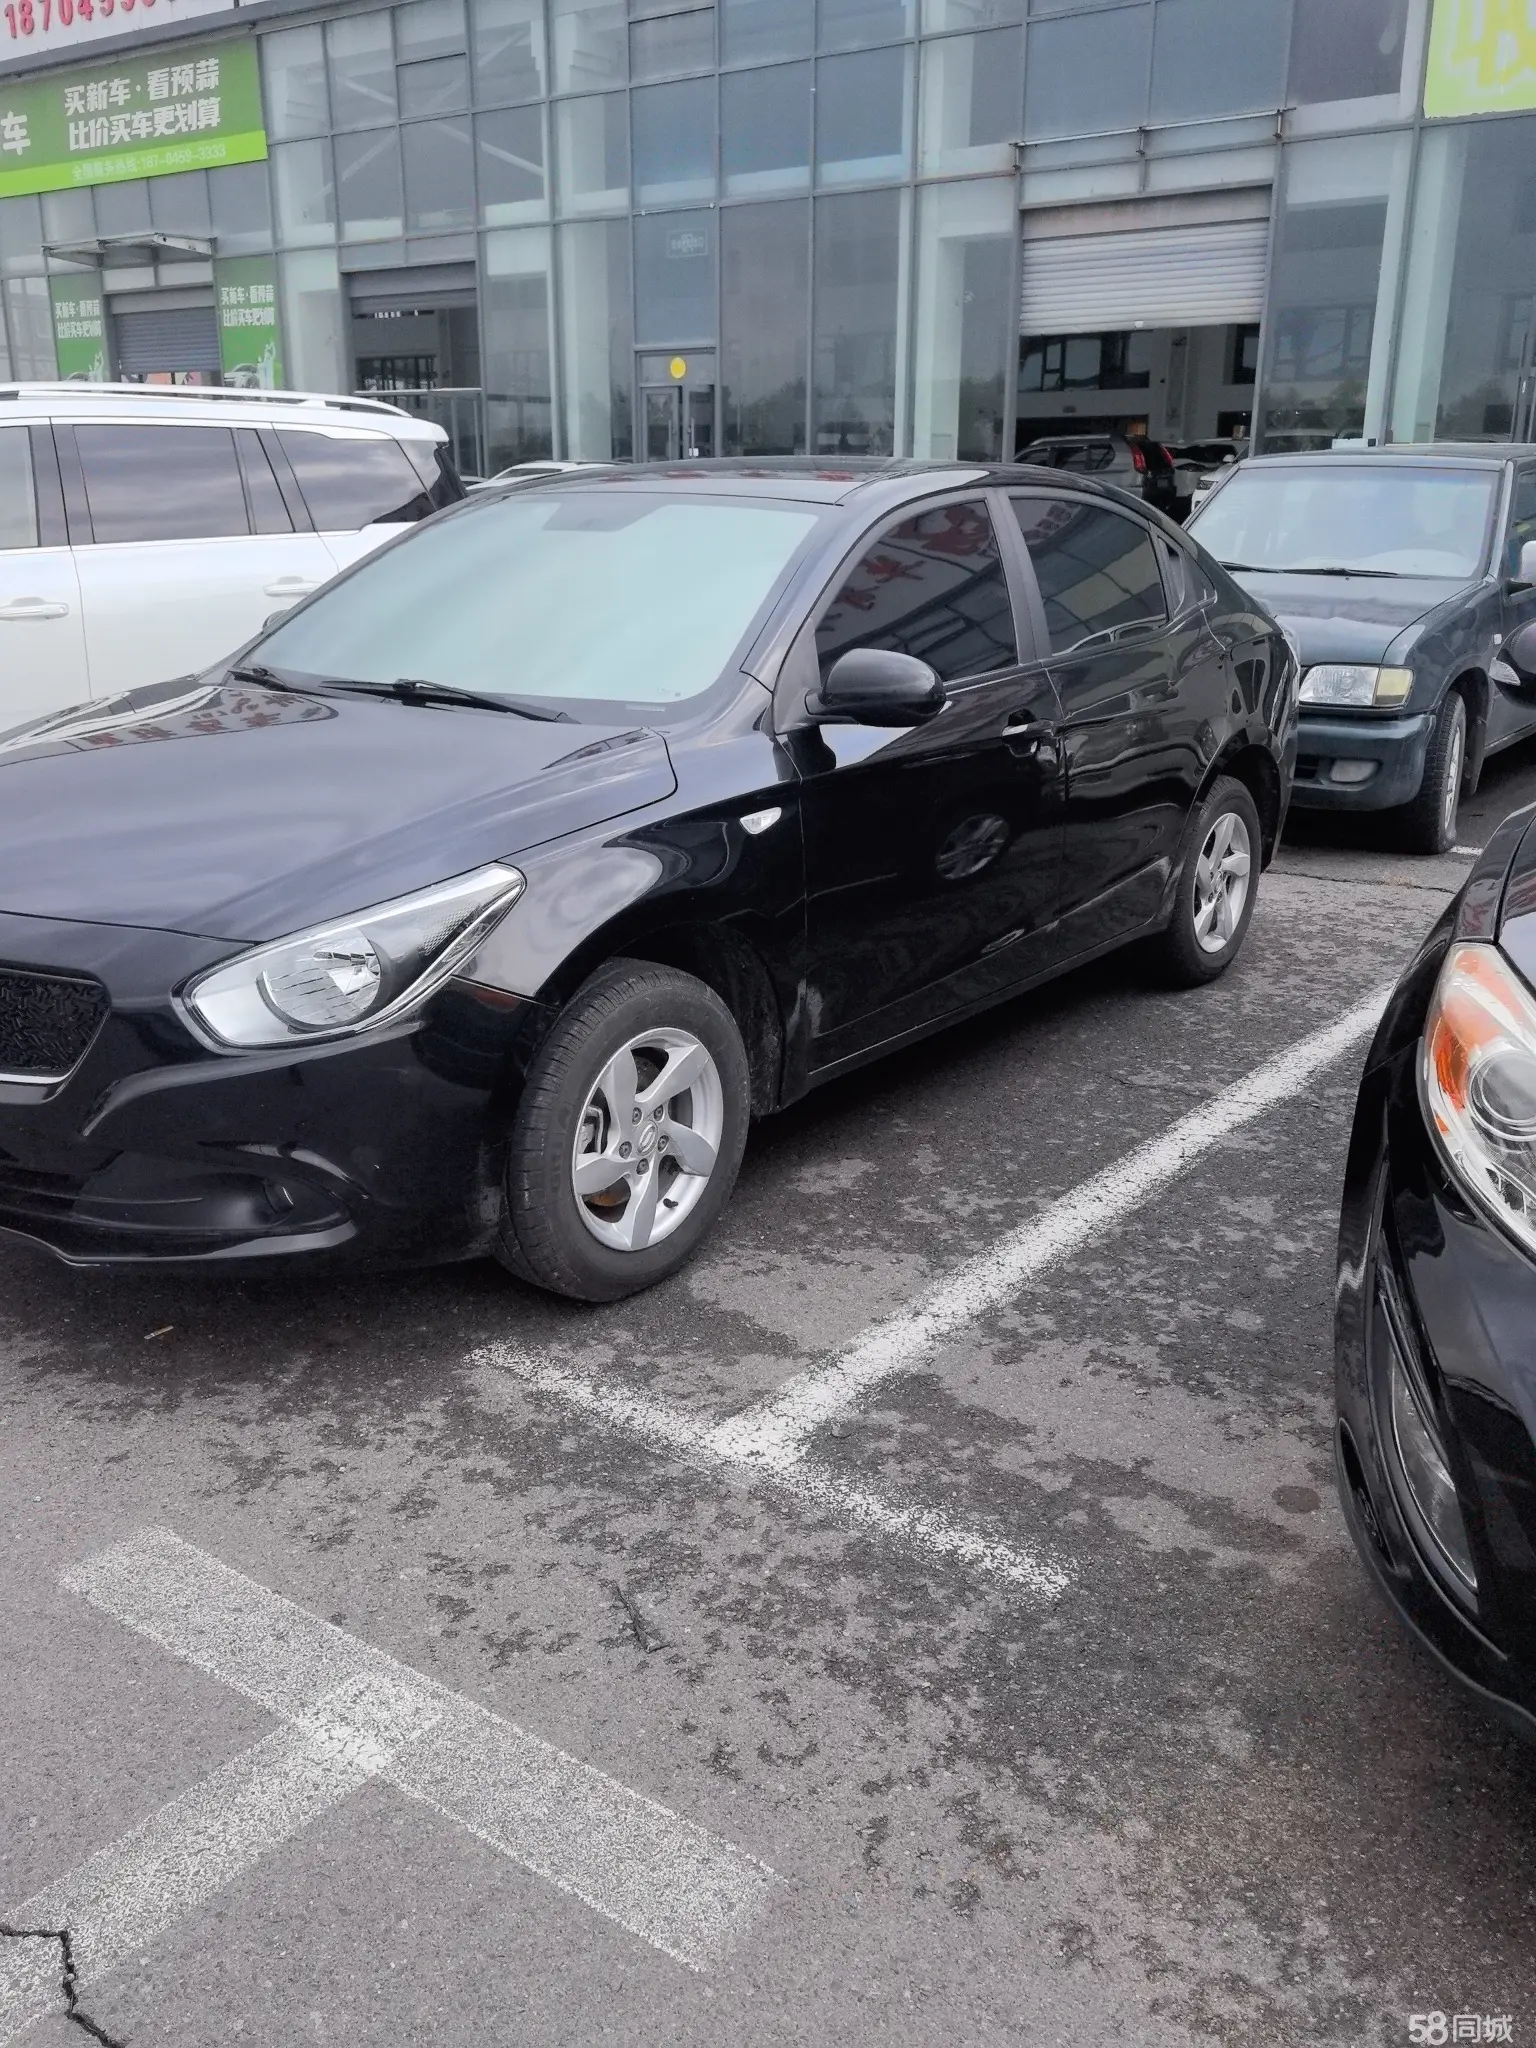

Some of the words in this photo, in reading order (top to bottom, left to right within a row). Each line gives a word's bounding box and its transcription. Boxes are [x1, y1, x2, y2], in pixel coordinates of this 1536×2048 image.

[1, 110, 31, 156] 车
[68, 97, 222, 151] 比价买车更划算
